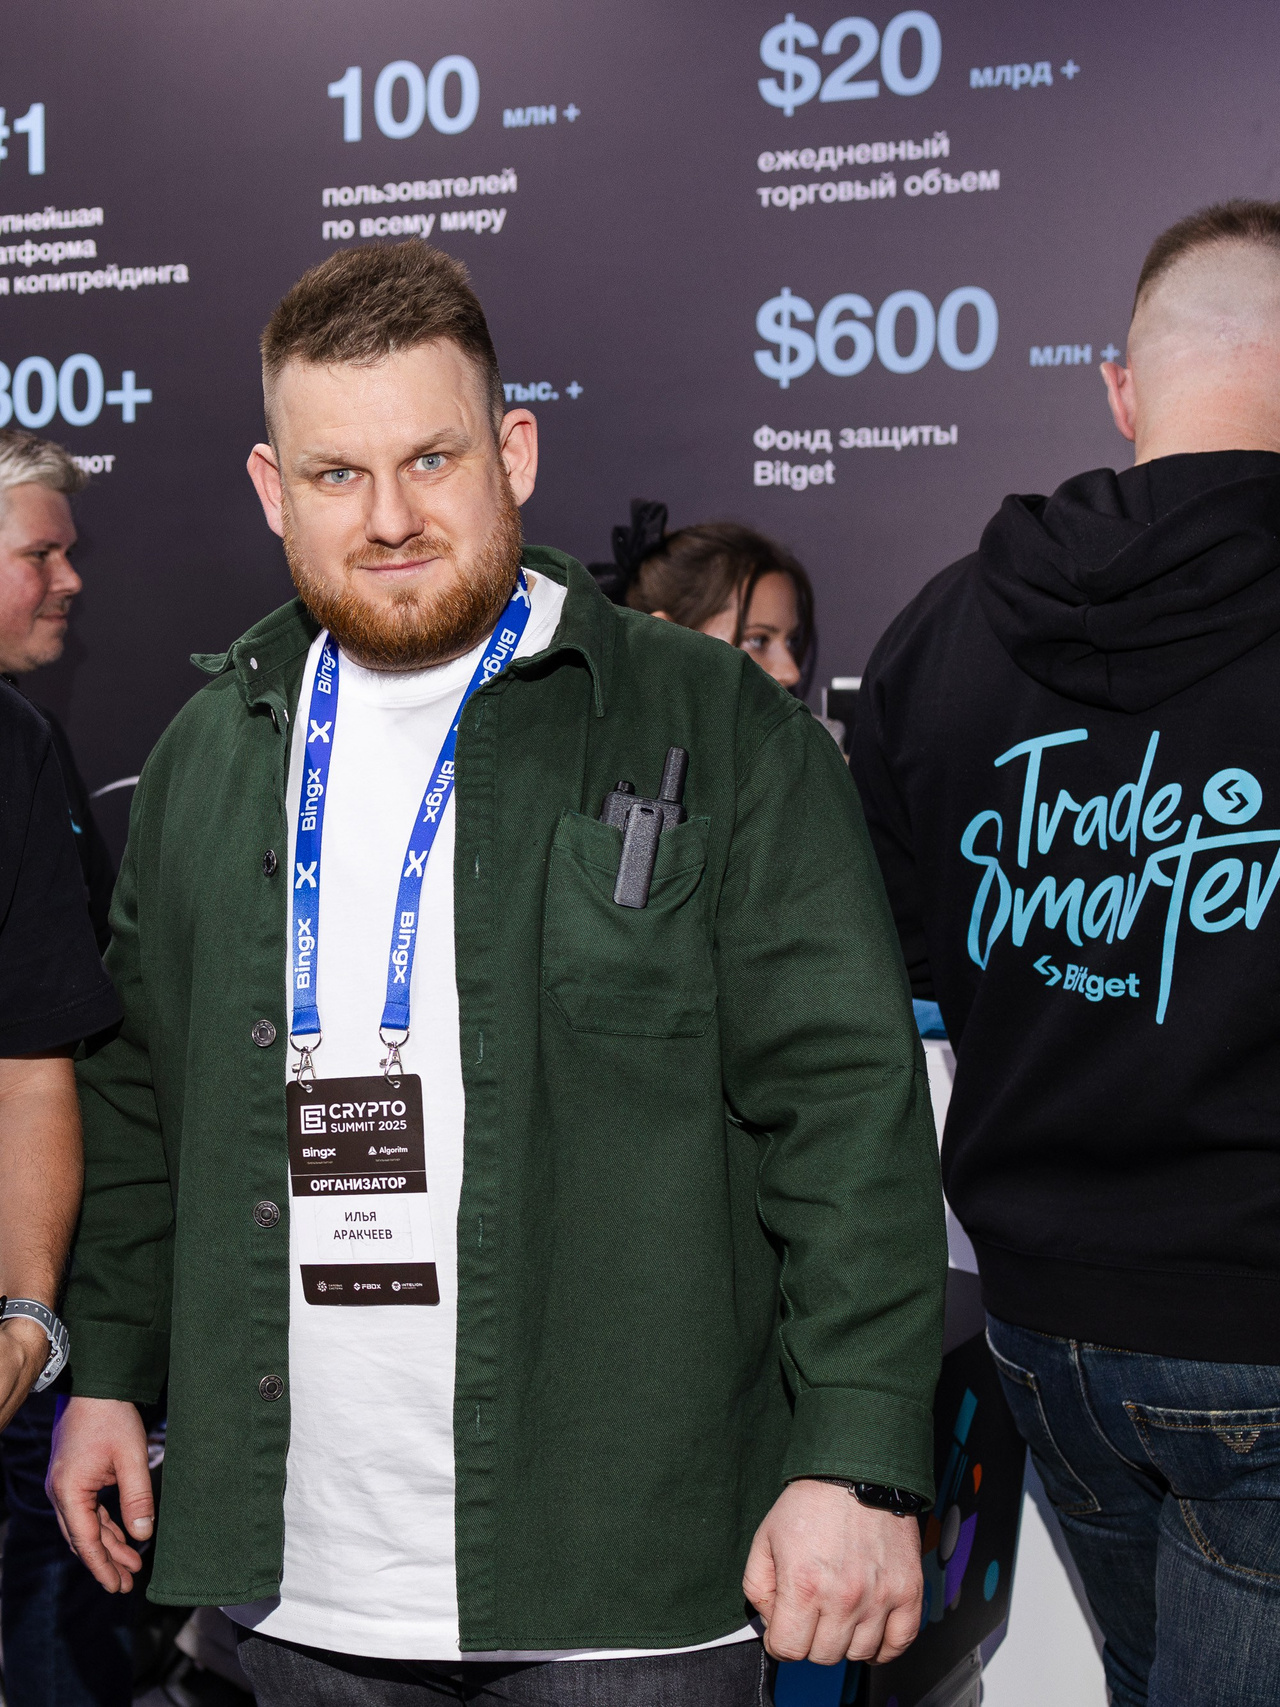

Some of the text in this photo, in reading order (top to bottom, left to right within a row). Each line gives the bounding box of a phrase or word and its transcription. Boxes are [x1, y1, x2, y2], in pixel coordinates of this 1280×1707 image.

[757, 10, 943, 117] $20
[969, 61, 1054, 90] млрд
[327, 54, 480, 143] 100
[502, 104, 557, 128] млн
[757, 130, 950, 172] ежедневный
[322, 167, 518, 207] пользователей
[756, 167, 1000, 211] торговый объем
[322, 207, 507, 240] по всему миру
[13, 263, 190, 294] копитрейдинга
[753, 285, 999, 390] $600
[1029, 343, 1092, 367] млн
[502, 381, 560, 403] тыс.
[753, 424, 958, 453] Фонд защиты
[753, 459, 836, 491] Bitget
[993, 728, 1183, 869] Trade
[1063, 963, 1140, 1002] Bitget
[328, 1100, 407, 1120] CRYPTO
[330, 1120, 407, 1134] SUMMIT 2025
[379, 1146, 409, 1156] Algoritm
[310, 1176, 407, 1192] ОРГАНИЗАТОР
[344, 1211, 377, 1222] ИЛЬЯ
[333, 1228, 393, 1240] АРАКЧЕЕВ
